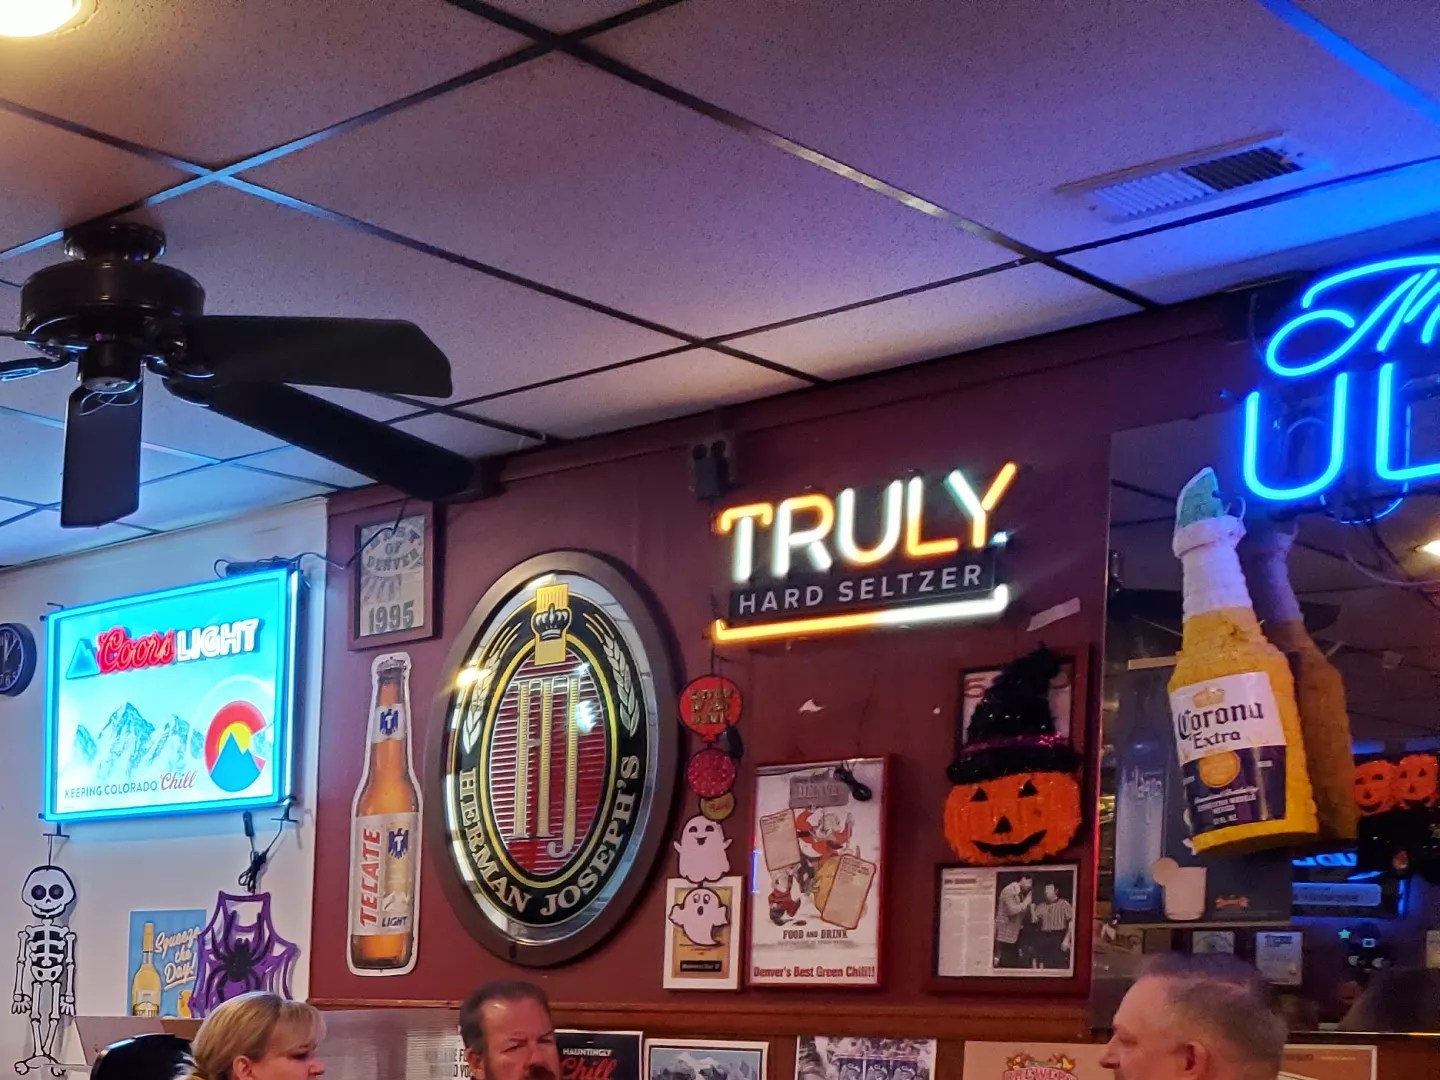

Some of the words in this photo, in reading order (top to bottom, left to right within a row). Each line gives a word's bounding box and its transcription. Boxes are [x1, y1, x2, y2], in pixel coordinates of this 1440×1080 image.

[716, 462, 1018, 583] TRULY
[738, 585, 824, 616] HARD
[838, 564, 982, 601] SELTZER
[368, 600, 415, 634] 1995
[98, 626, 177, 674] Coors
[176, 618, 261, 663] LIGHT
[1178, 702, 1264, 741] Corona
[1192, 730, 1242, 749] Extra
[64, 785, 103, 800] KEEPING
[104, 781, 159, 796] COLORADO
[159, 771, 198, 792] Chill
[459, 769, 532, 914] HERMAN
[540, 755, 641, 918] JOSEPH'S
[358, 828, 382, 928] TECATE
[380, 916, 408, 929] LIGHT
[782, 929, 804, 940] FOOD
[820, 929, 848, 939] DRINK
[175, 945, 192, 963] the
[753, 966, 792, 977] Denver's
[793, 966, 815, 977] Best
[816, 965, 843, 977] Green
[562, 1048, 613, 1056] HAUNTINGLY
